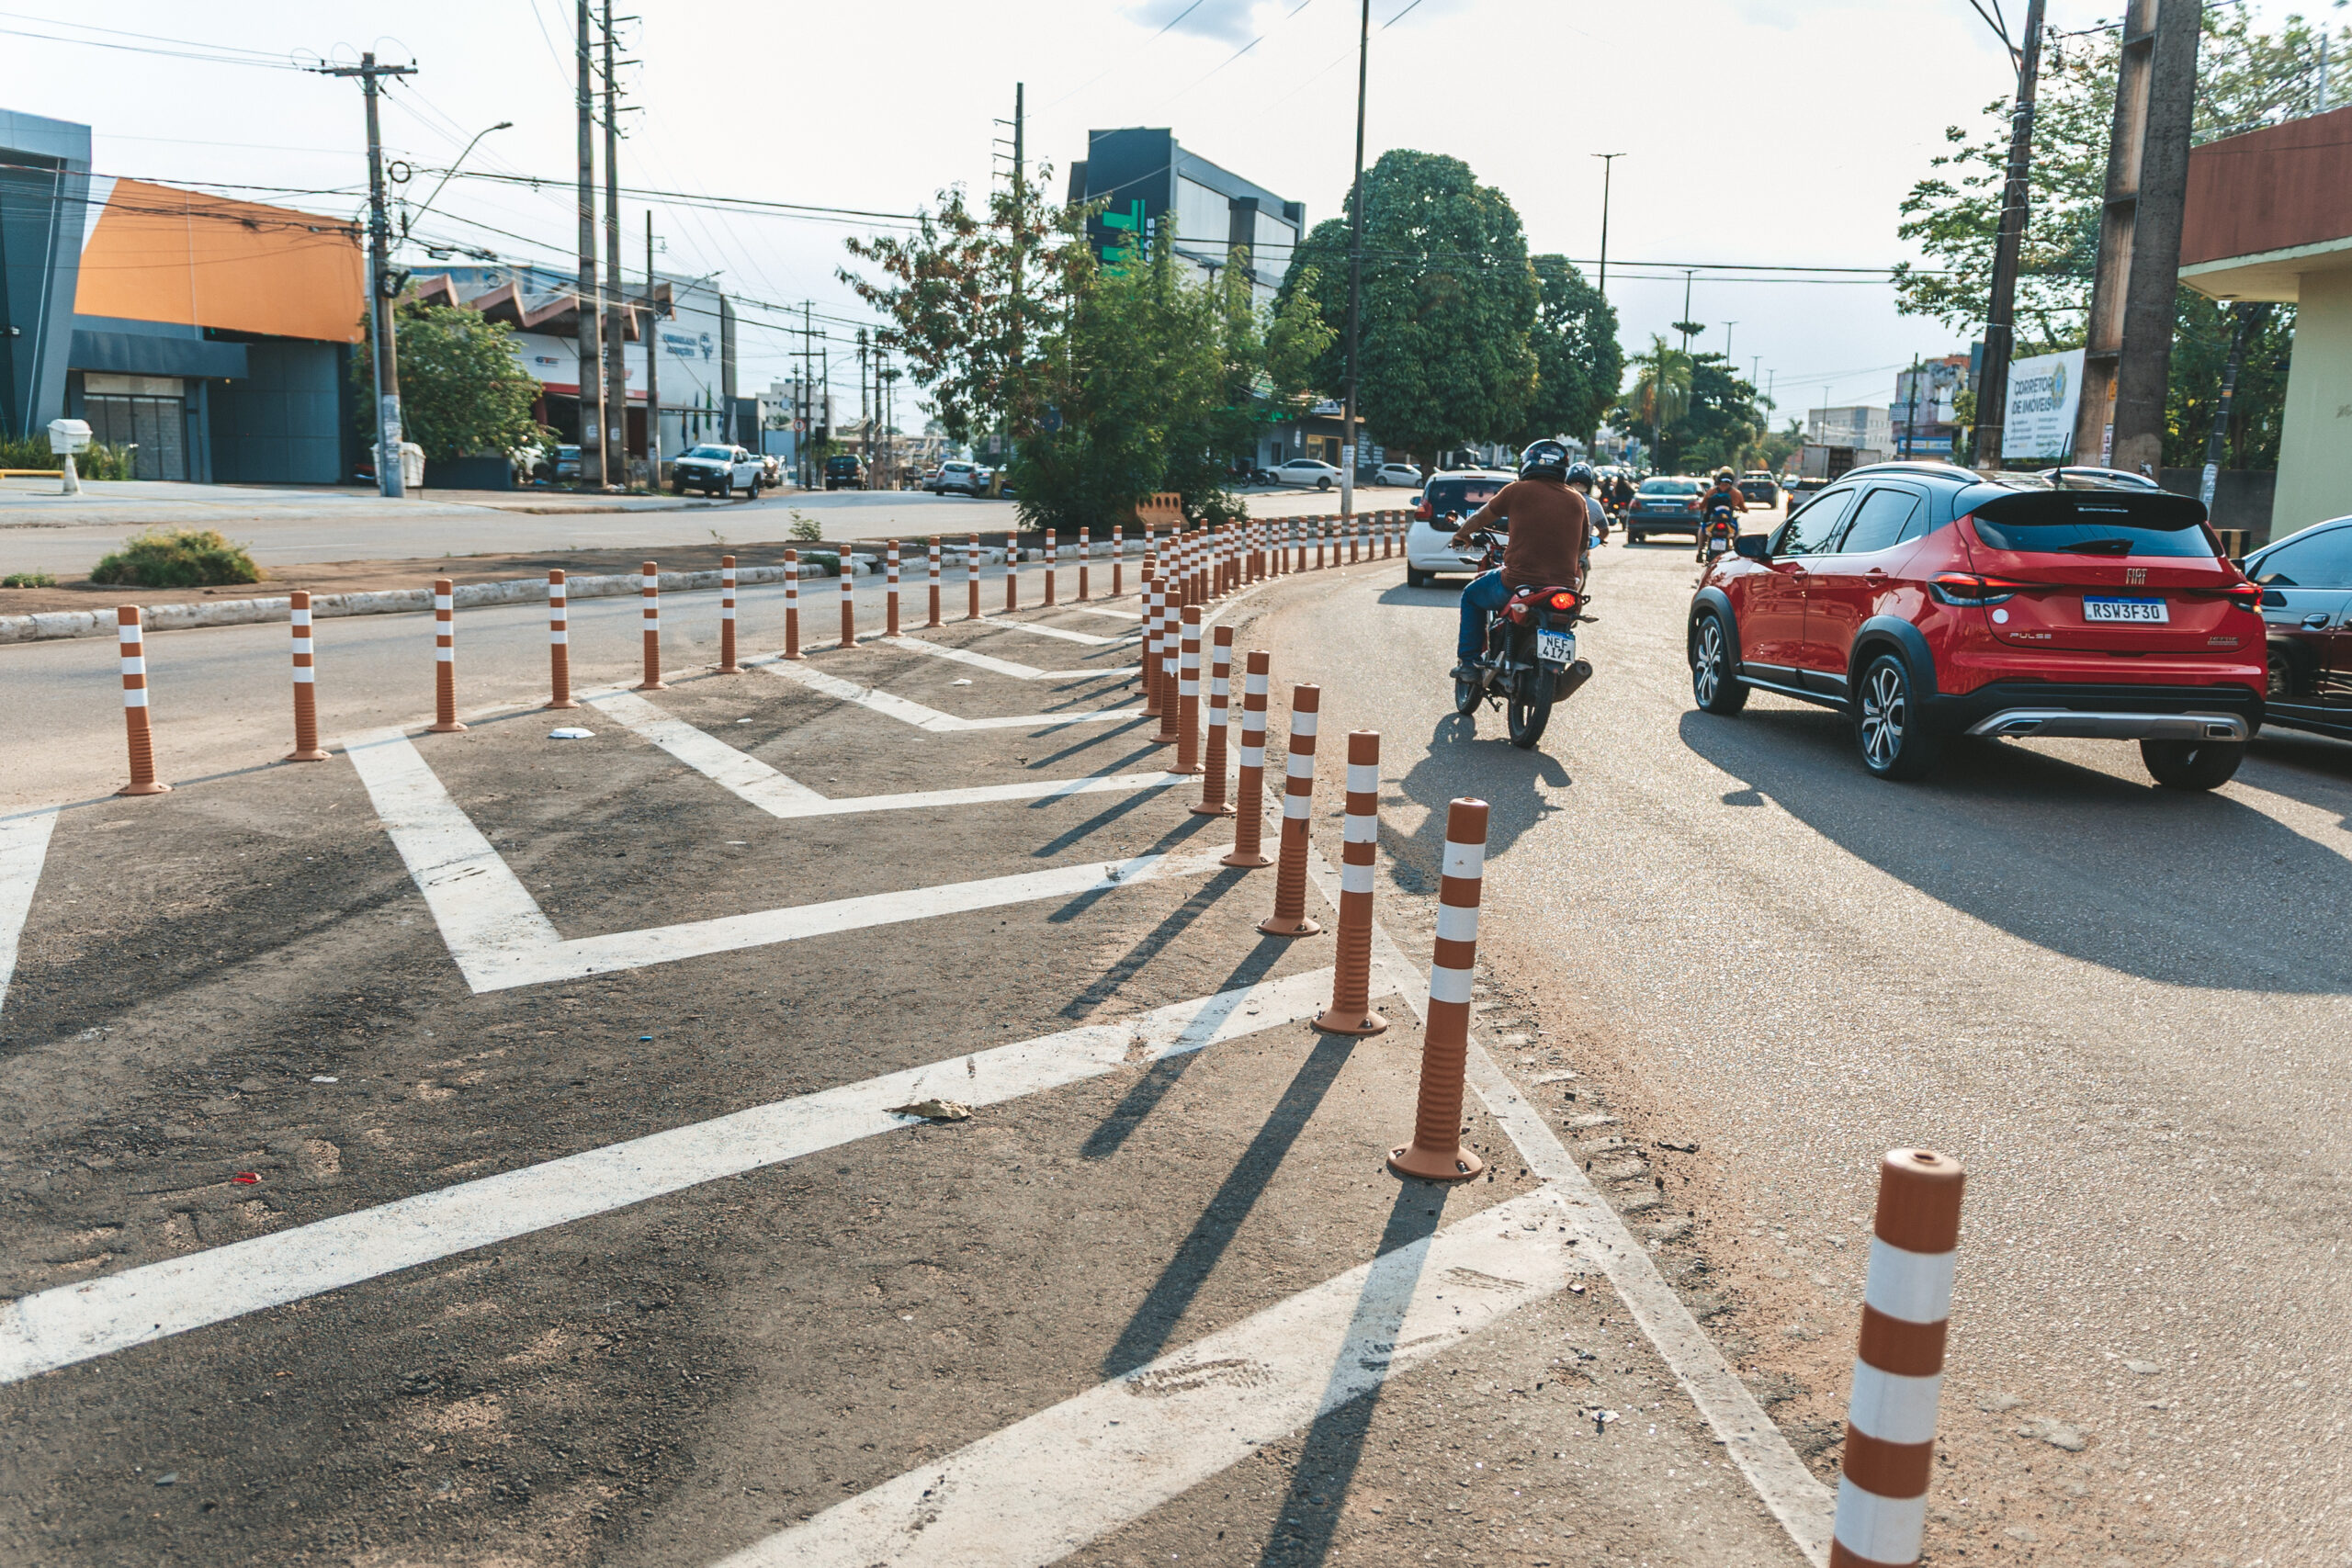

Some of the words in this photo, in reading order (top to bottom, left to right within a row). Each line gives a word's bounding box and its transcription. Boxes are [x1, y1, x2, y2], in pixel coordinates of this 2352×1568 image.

[2014, 376, 2053, 396] CORRETOR
[2011, 400, 2022, 414] DE
[2126, 569, 2147, 584] FIAT
[2093, 603, 2160, 619] RSW3F30
[1546, 637, 1568, 649] NEF
[1543, 646, 1571, 661] 4I71
